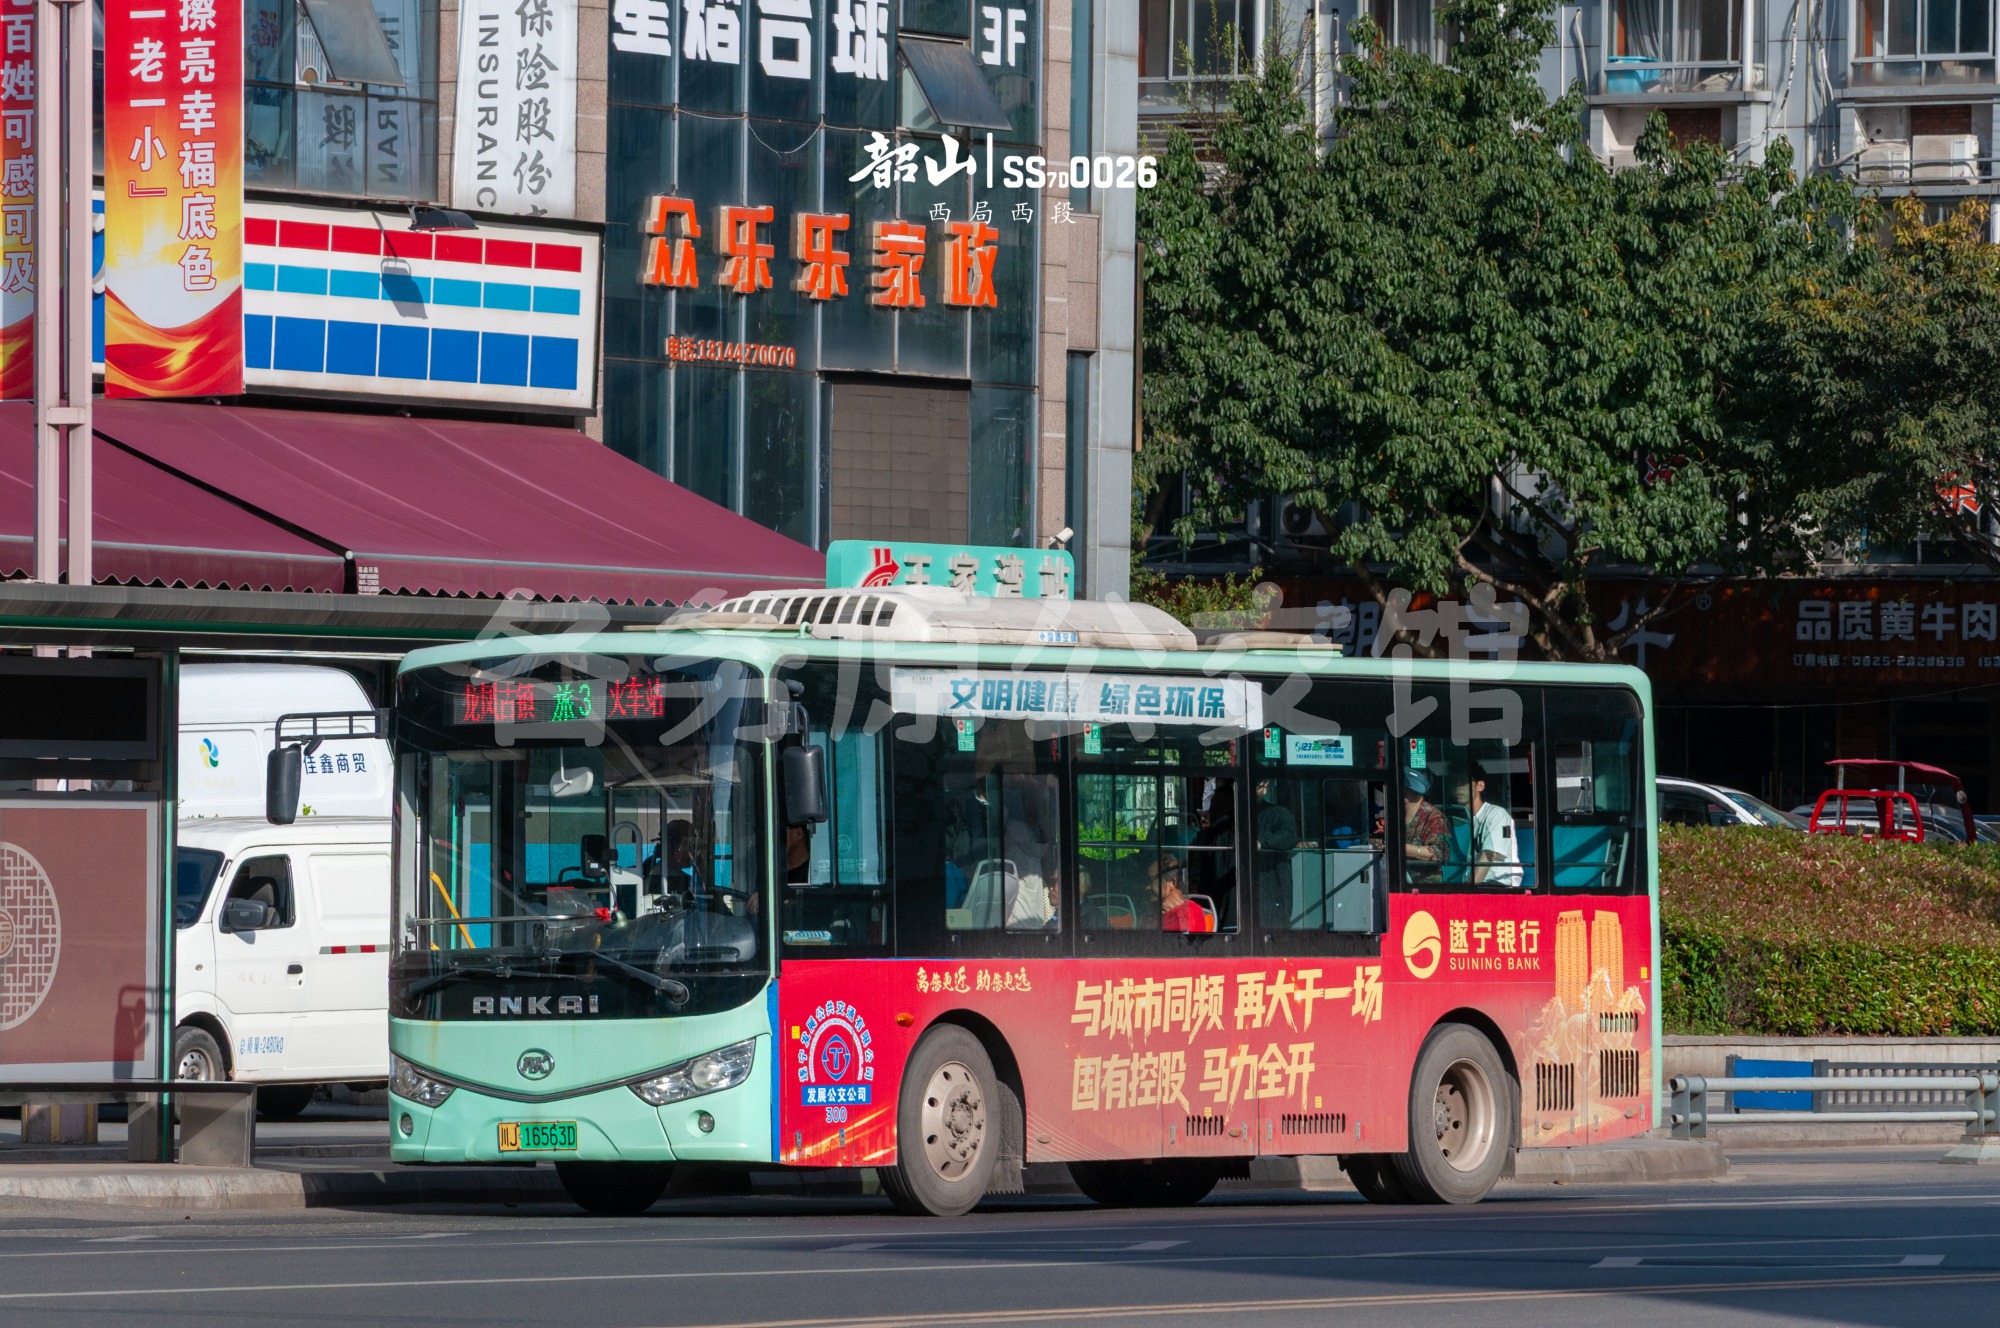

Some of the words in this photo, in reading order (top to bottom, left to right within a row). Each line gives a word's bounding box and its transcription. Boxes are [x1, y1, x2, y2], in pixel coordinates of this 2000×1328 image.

[982, 5, 1026, 67] 3F
[513, 0, 559, 217] 保险股份
[0, 0, 34, 293] 百姓可感可及
[178, 0, 217, 292] 擦亮幸福底色
[643, 196, 998, 309] 众乐乐家政
[1796, 599, 1998, 641] 品质黄牛肉
[609, 676, 665, 718] 火车站
[949, 677, 1080, 714] 文明健康
[1100, 681, 1226, 719] 绿色环保
[1449, 919, 1541, 954] 遂宁银行
[1449, 957, 1502, 971] SUINING
[1508, 957, 1540, 970] BANK
[472, 994, 599, 1014] ANKAI
[1071, 974, 1226, 1050] 与城市同频
[1234, 965, 1384, 1034] 再大干一场
[807, 1086, 867, 1104] 发展公交公司
[1071, 1051, 1190, 1115] 国有控股
[1199, 1042, 1316, 1126] 马力全开
[826, 1106, 848, 1123] 300
